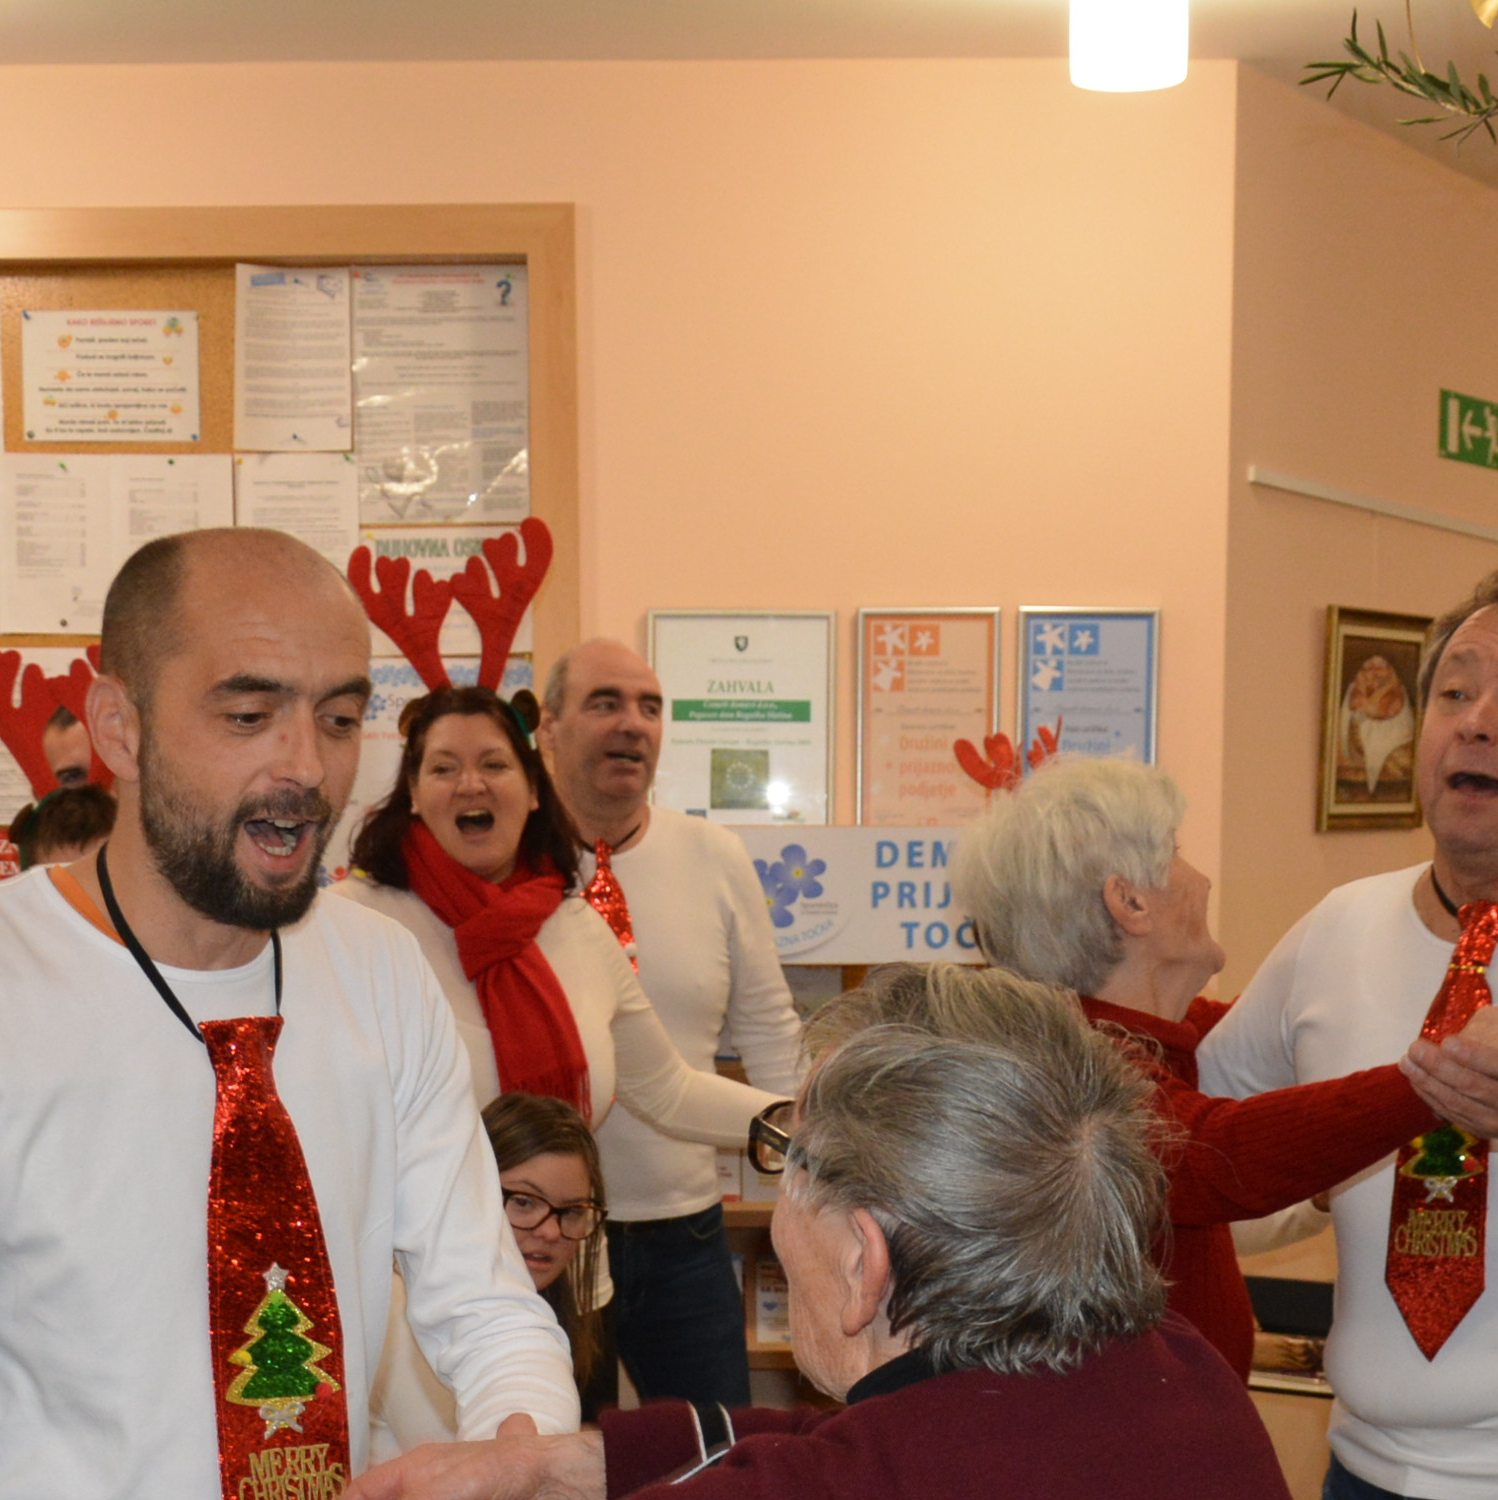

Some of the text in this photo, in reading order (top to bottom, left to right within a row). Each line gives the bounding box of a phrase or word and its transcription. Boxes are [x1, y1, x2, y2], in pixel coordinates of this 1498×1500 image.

[707, 680, 774, 694] ZAHVALA
[1408, 1208, 1469, 1233] MERRY
[1394, 1224, 1478, 1257] CHRISTMAS
[249, 1443, 330, 1483] MERRY
